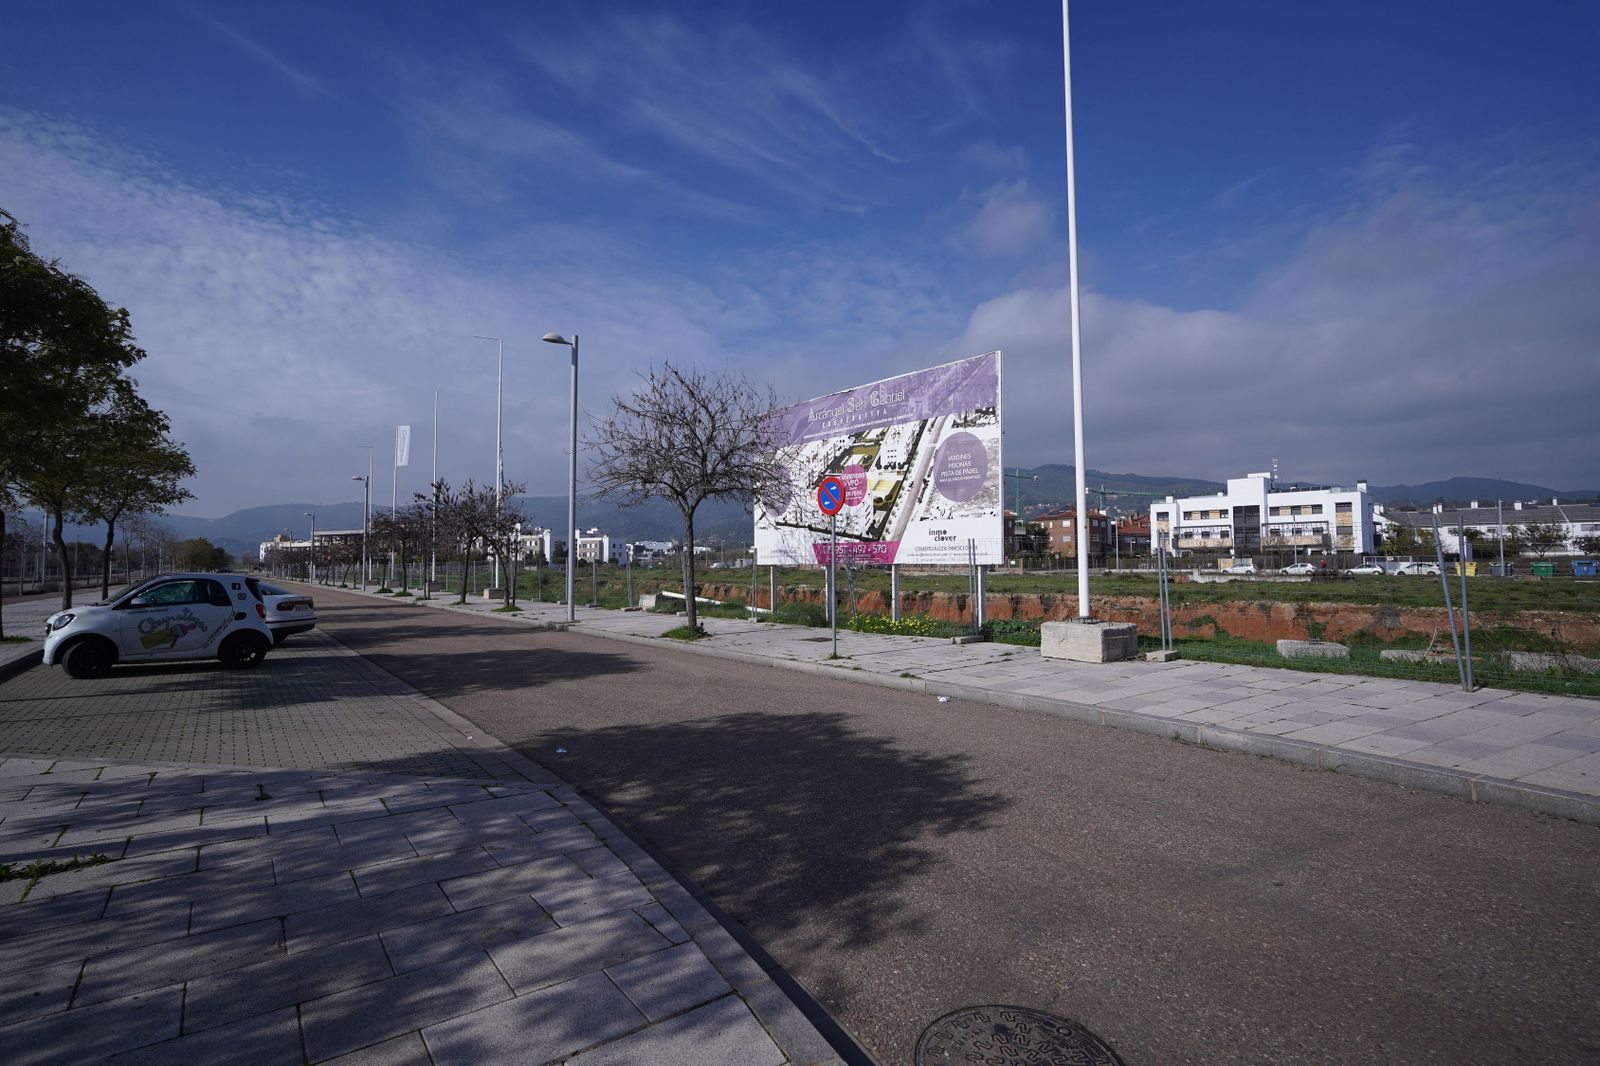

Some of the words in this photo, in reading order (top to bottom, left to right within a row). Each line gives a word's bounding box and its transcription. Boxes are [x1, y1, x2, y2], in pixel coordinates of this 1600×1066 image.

[870, 389, 905, 407] Gabriel
[934, 533, 957, 542] clover
[872, 544, 887, 554] 570
